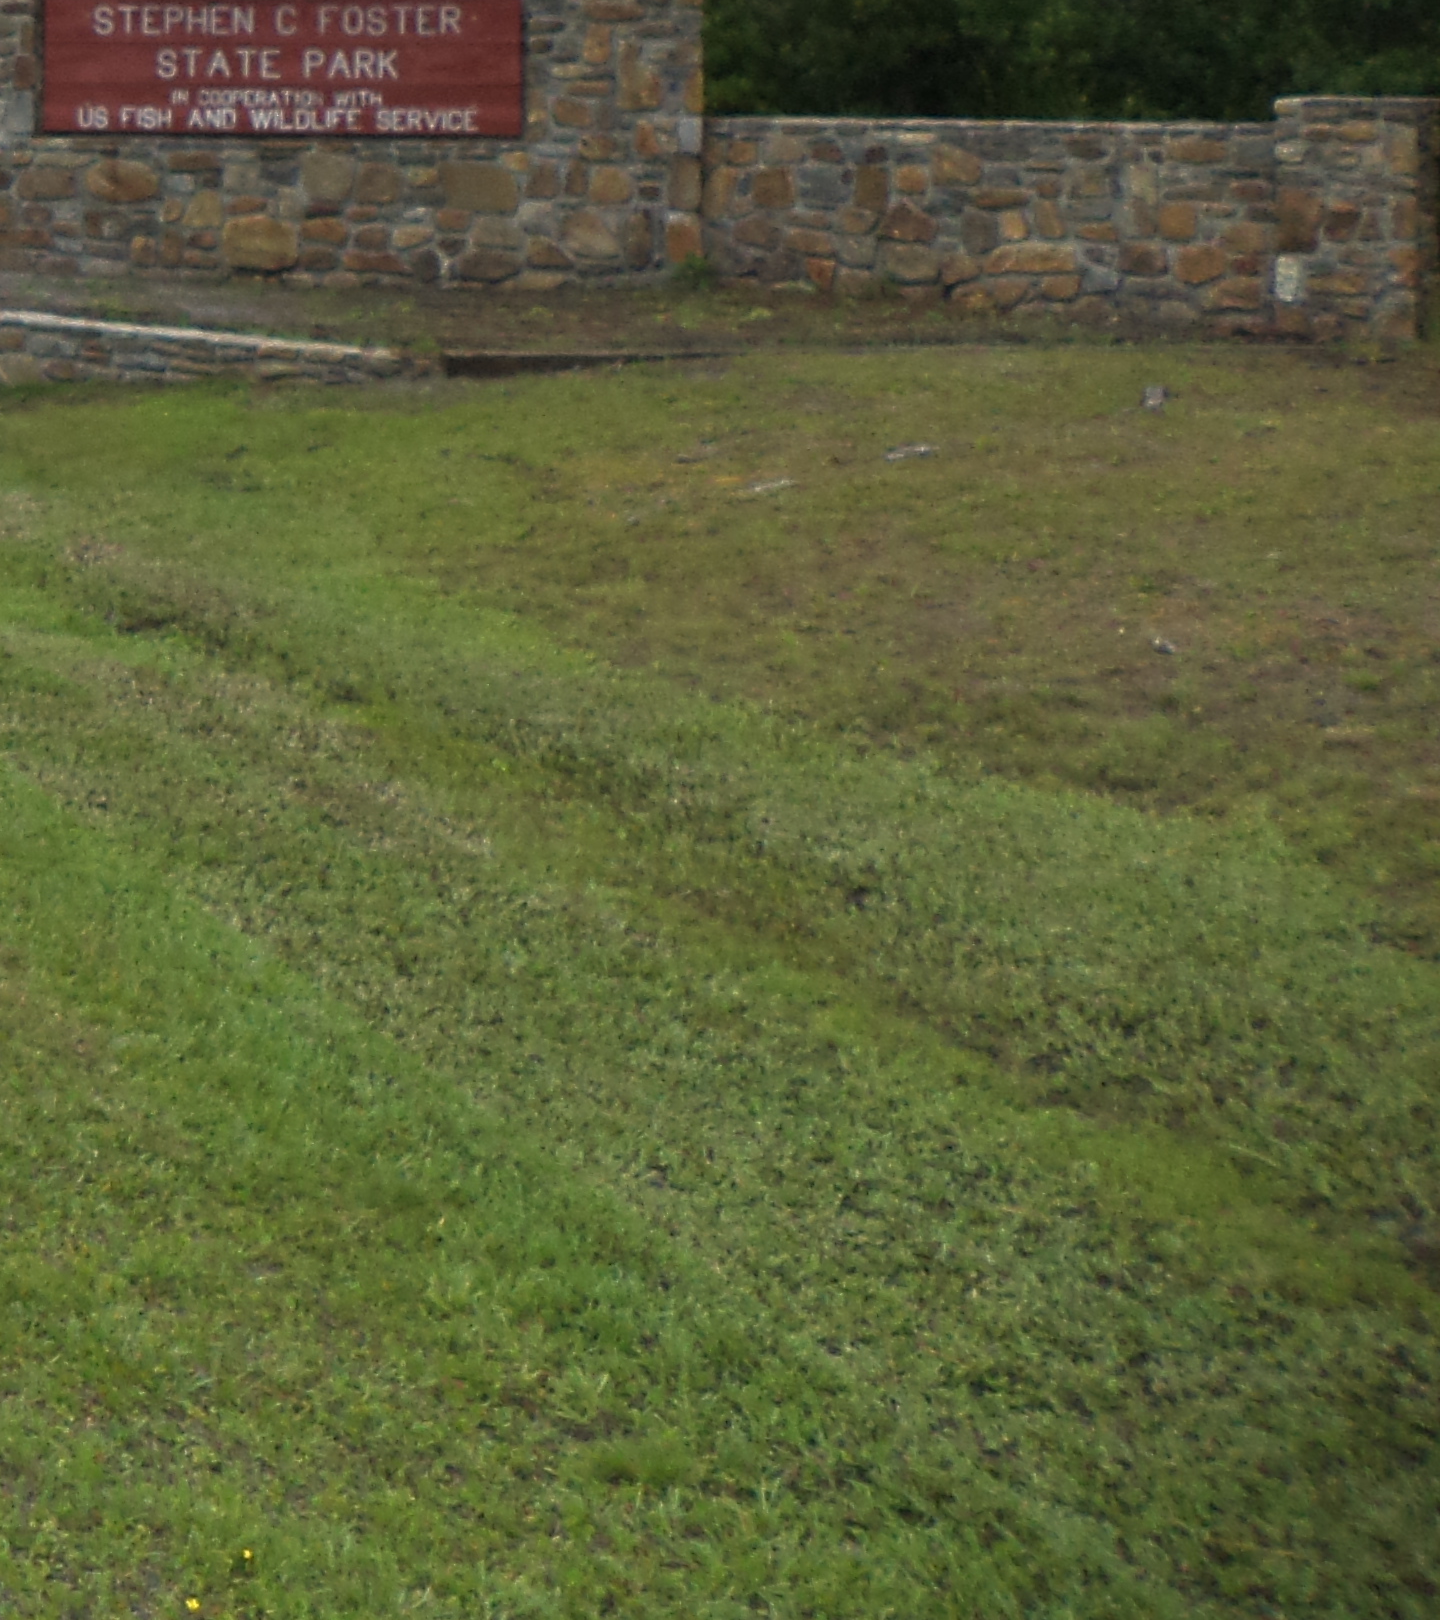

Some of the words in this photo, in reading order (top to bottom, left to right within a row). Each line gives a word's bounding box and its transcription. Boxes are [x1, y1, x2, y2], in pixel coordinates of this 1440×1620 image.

[93, 5, 254, 35] STEPHEN
[276, 7, 298, 34] C
[318, 6, 461, 35] FOSTER
[156, 49, 280, 79] STATE
[303, 50, 398, 79] PARK
[334, 92, 382, 107] WITH
[77, 107, 108, 128] US
[119, 107, 172, 128] FISH
[189, 107, 236, 129] AND
[249, 108, 361, 130] WILDLIFE
[377, 108, 477, 131] SERVICE
